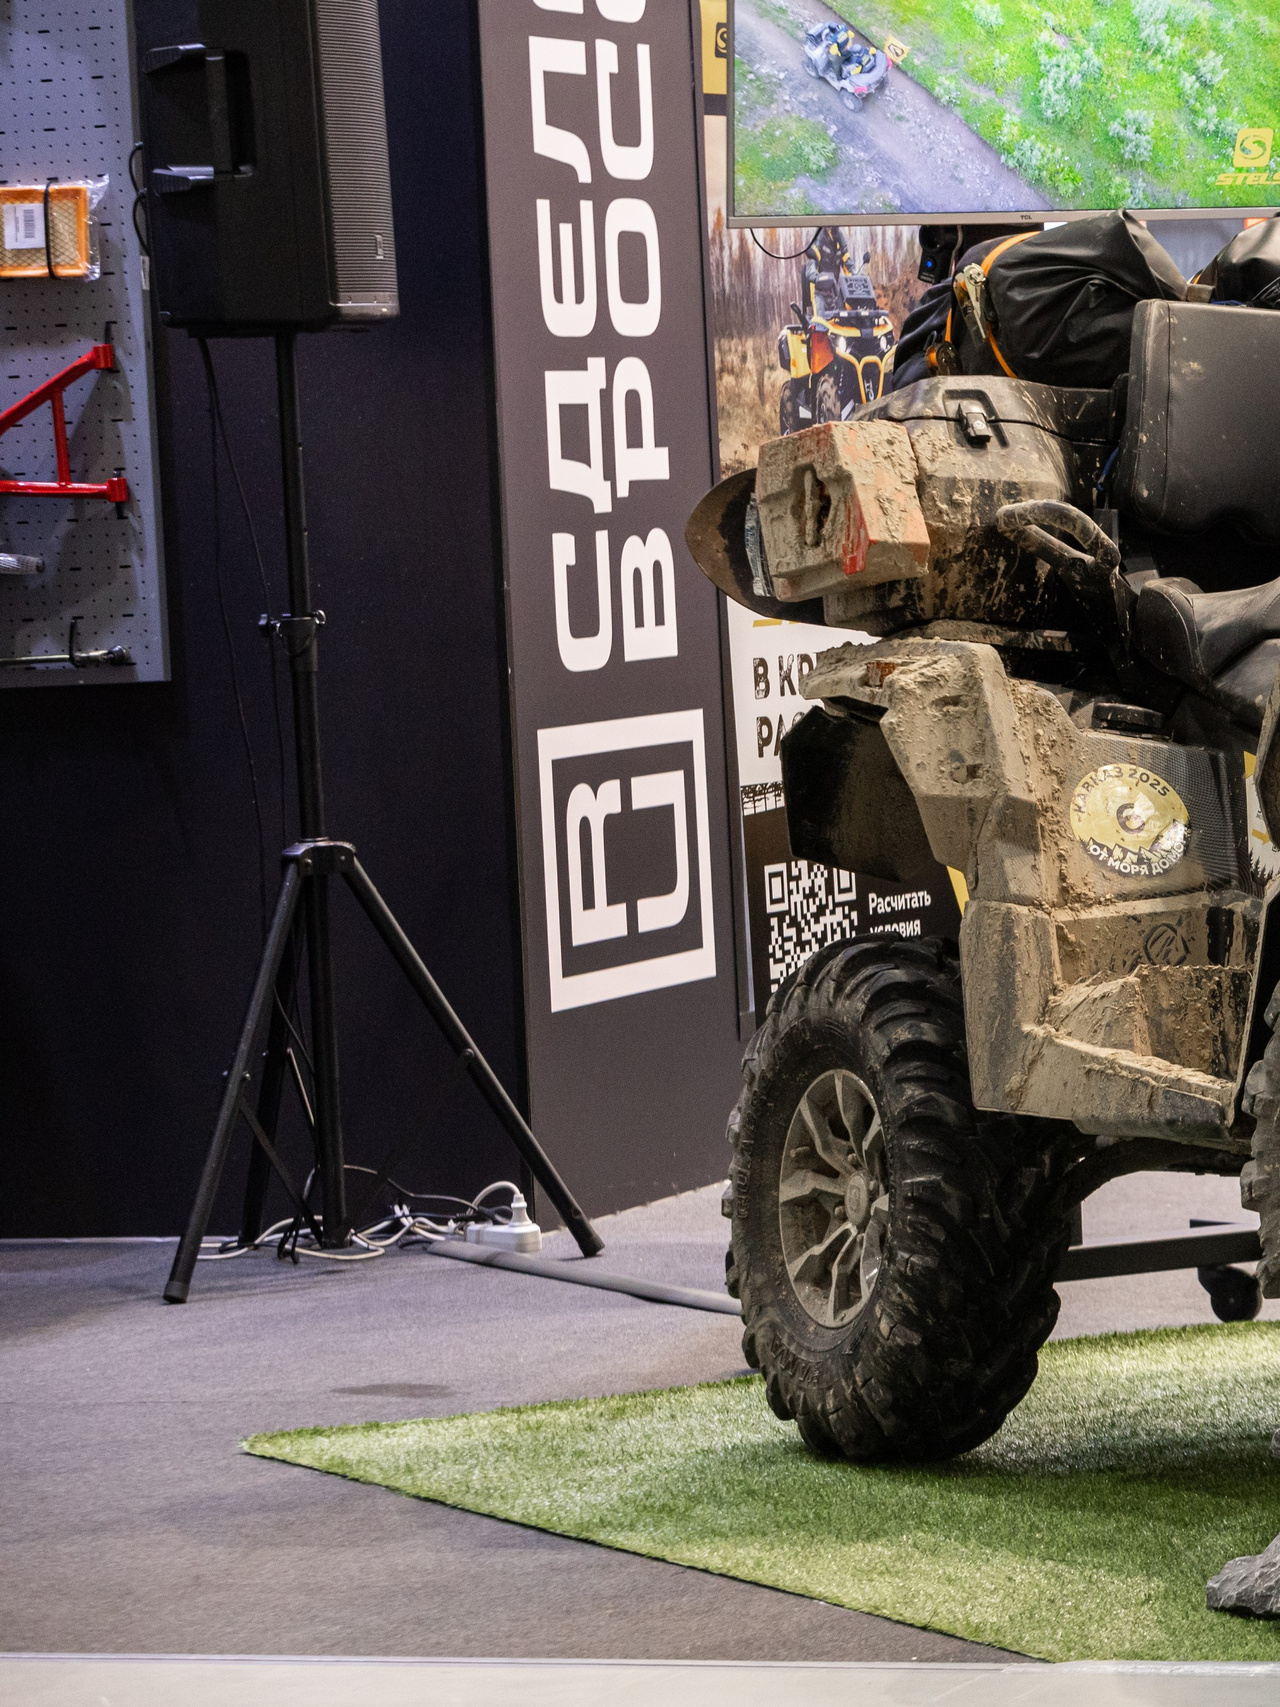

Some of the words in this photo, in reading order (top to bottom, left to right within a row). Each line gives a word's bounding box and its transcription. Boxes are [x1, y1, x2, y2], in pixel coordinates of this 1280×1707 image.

[595, 0, 670, 498] РОС
[529, 0, 612, 672] СДЕЛ
[753, 657, 771, 700] В
[778, 653, 819, 697] КР
[756, 711, 806, 758] РА
[1128, 767, 1170, 797] 2025
[1089, 844, 1109, 862] ОТ
[1107, 857, 1149, 875] МОРЯ
[1151, 858, 1170, 876] ДО
[868, 890, 932, 916] Расчитать
